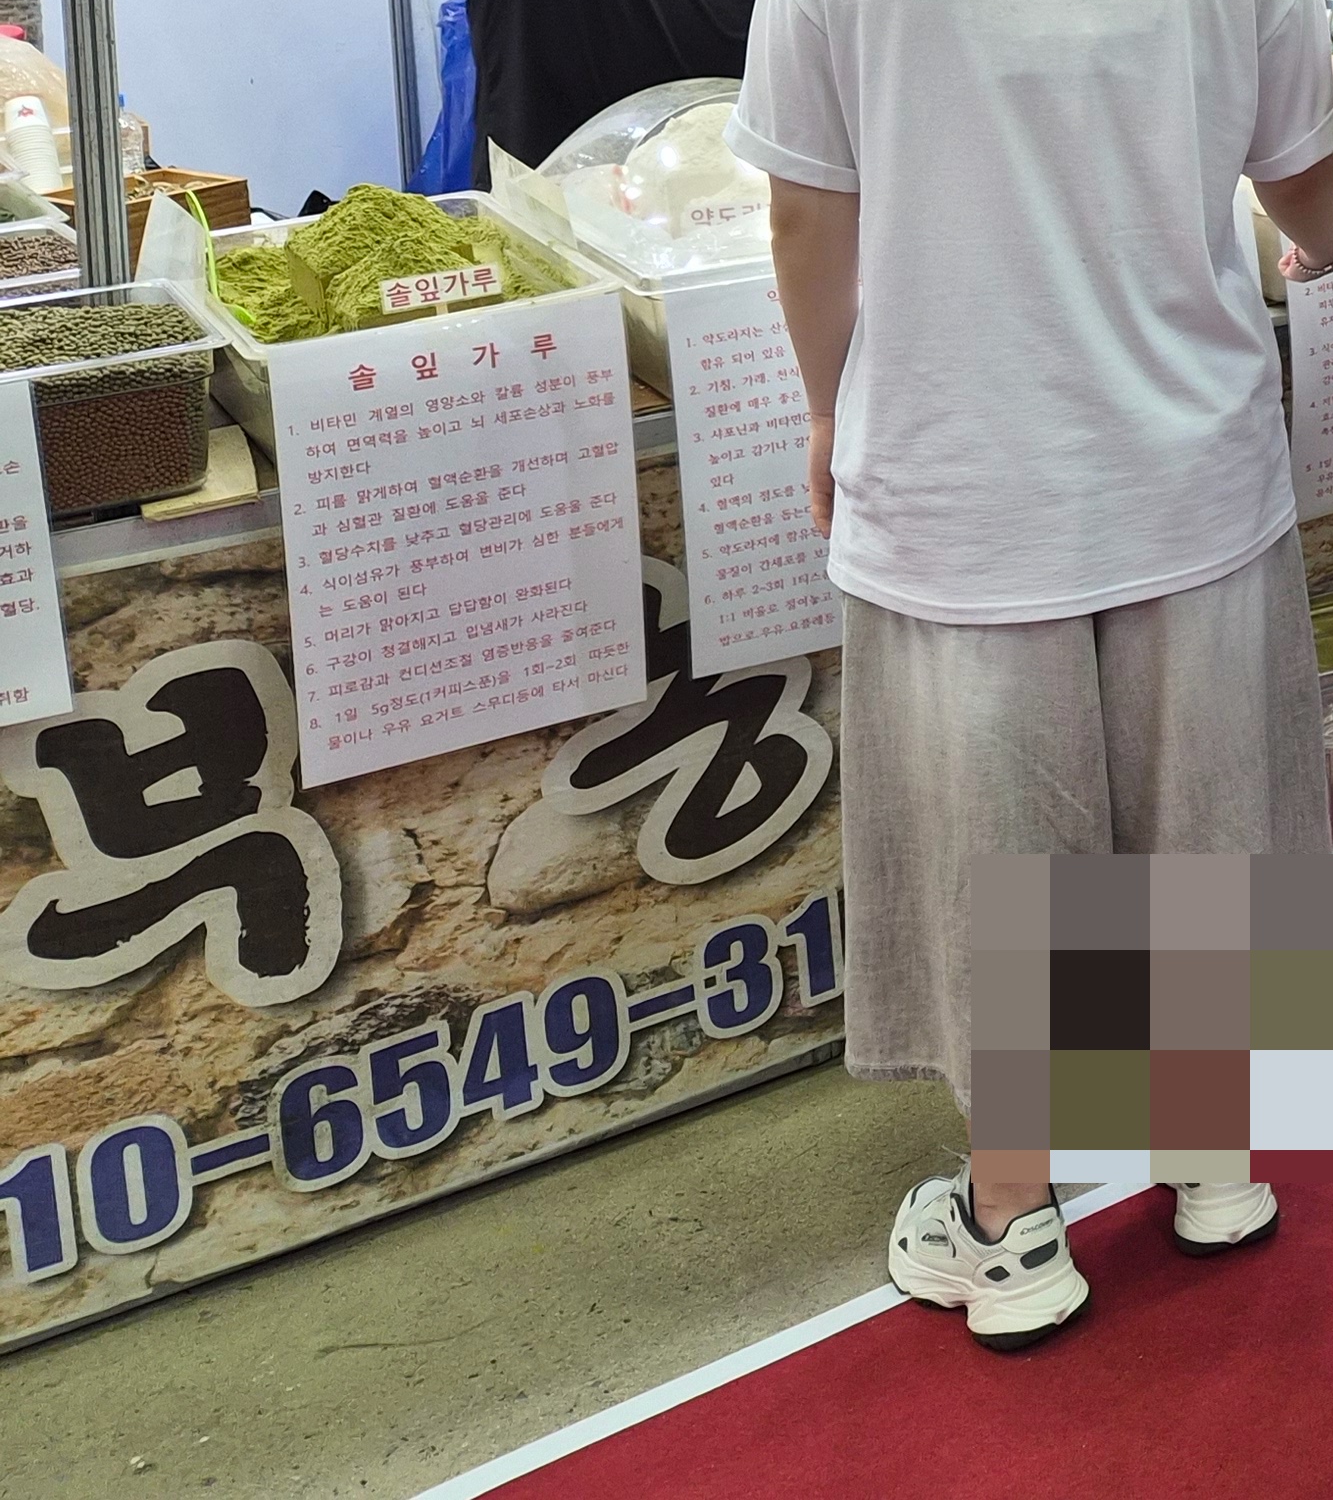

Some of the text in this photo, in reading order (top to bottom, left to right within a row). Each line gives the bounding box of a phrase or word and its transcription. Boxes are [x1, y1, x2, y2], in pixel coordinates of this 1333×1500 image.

[385, 266, 499, 309] 솔잎가루
[702, 326, 763, 346] 약도라지는
[348, 333, 557, 392] 솔 잎 가 루
[700, 345, 785, 371] 함유 되어 있음
[310, 368, 614, 433] 비타민 계열의 영양소와 성분이 풍부
[705, 400, 741, 418] 질환에
[306, 391, 615, 459] 하여 면역력을 높이고 뇌 세포손상과 노화를
[711, 421, 760, 440] 사포닌과
[308, 461, 371, 485] 방지한다
[707, 439, 788, 465] 높이고 감기나
[316, 441, 619, 512] 피를 맑게하여 혈액순환을 개선하며 고혈압
[710, 473, 734, 488] 있다
[312, 483, 526, 538] 과 심혈관 질환에 도움을 준다
[319, 492, 617, 565] 혈당수치를 낮추고 혈당관리에 도움을 준다
[322, 517, 624, 591] 식이섬유가 풍부하여 변비가 심한 분들에게
[720, 536, 780, 557] 약도라지에
[319, 583, 427, 618] 는 도움이 된다
[325, 578, 572, 643] 머리가 맑아지고 답답함이 완화된다
[722, 589, 746, 602] 하루
[326, 600, 588, 671] 구강이 입냄새가 사라진다
[328, 619, 616, 698] 피로감과 염증반응을 줄여준다
[328, 663, 629, 750] 물이나 우유 요거트 스무디등에 타서 마신다
[336, 708, 358, 723] 1일
